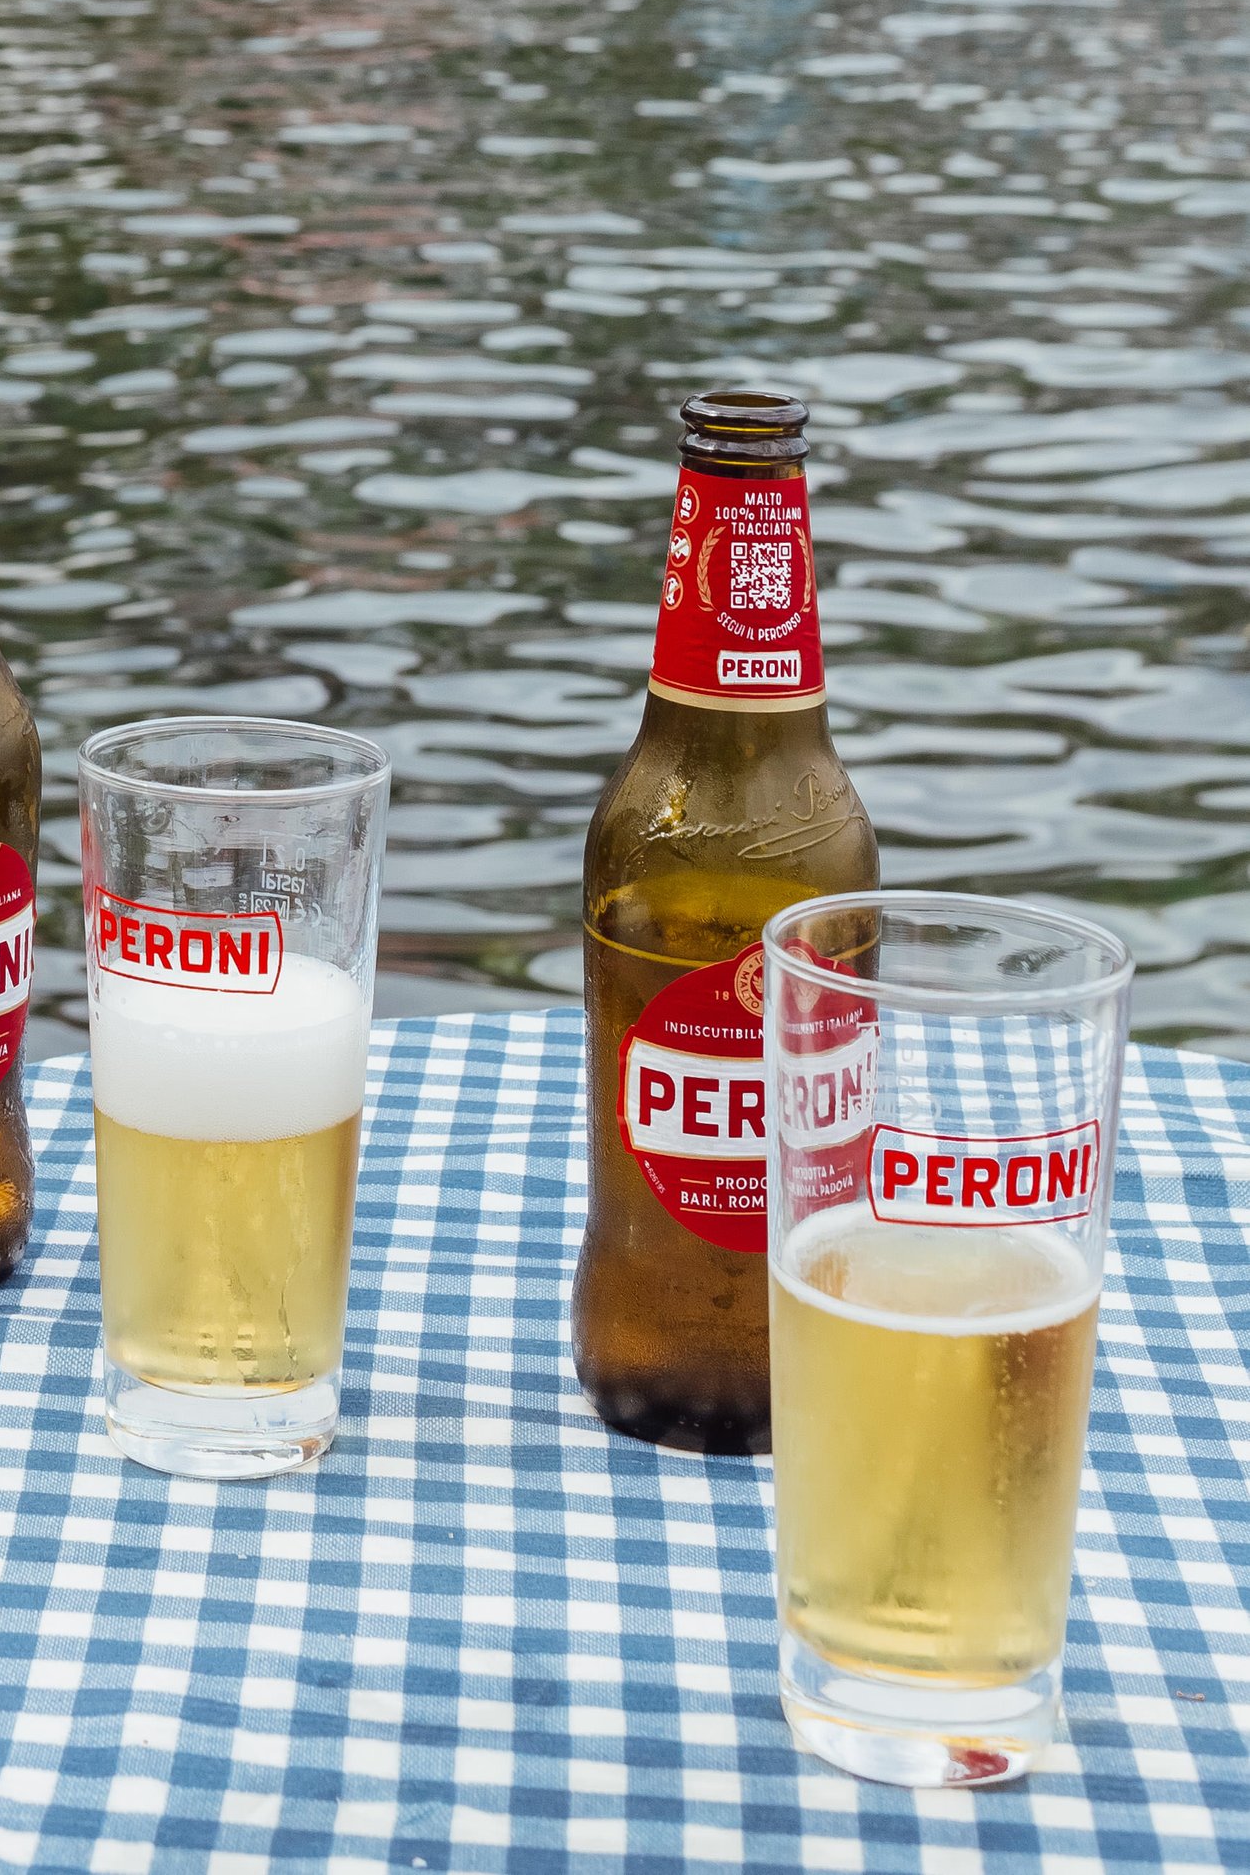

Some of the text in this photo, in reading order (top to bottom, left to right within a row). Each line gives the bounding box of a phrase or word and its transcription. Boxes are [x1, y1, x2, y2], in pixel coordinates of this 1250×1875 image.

[744, 492, 782, 506] MALTO
[715, 507, 802, 521] 100% ITALIANO
[731, 521, 792, 536] TRACCIATO
[716, 611, 801, 642] SEGUI IL PERCORSO
[722, 658, 798, 678] PERONI
[100, 908, 270, 975] PERONI
[715, 990, 730, 1001] 18
[740, 970, 760, 1009] MALTO
[882, 1144, 1091, 1208] PERONI
[680, 1190, 724, 1209] BARI,
